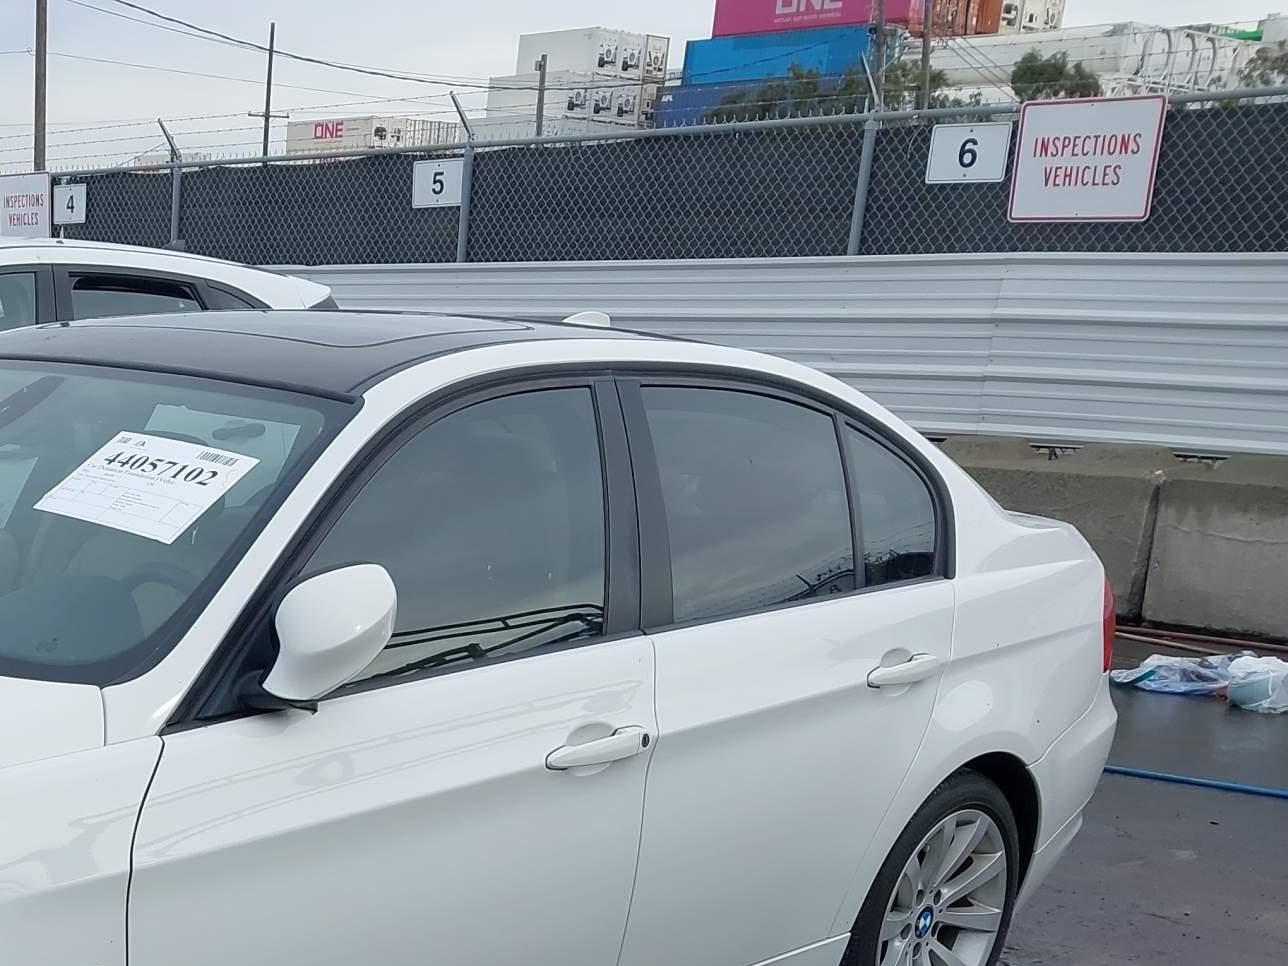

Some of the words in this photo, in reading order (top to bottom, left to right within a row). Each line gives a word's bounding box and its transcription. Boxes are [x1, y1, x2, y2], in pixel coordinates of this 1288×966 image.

[314, 122, 343, 139] ONE
[958, 138, 978, 168] 6
[1033, 133, 1142, 158] INSPECTIONS
[431, 171, 444, 196] 5
[1044, 165, 1121, 187] VEHICLES
[3, 193, 44, 209] INSPECTIONS
[66, 195, 75, 213] 4
[8, 212, 39, 226] VEHICLES
[104, 451, 219, 486] 44057102
